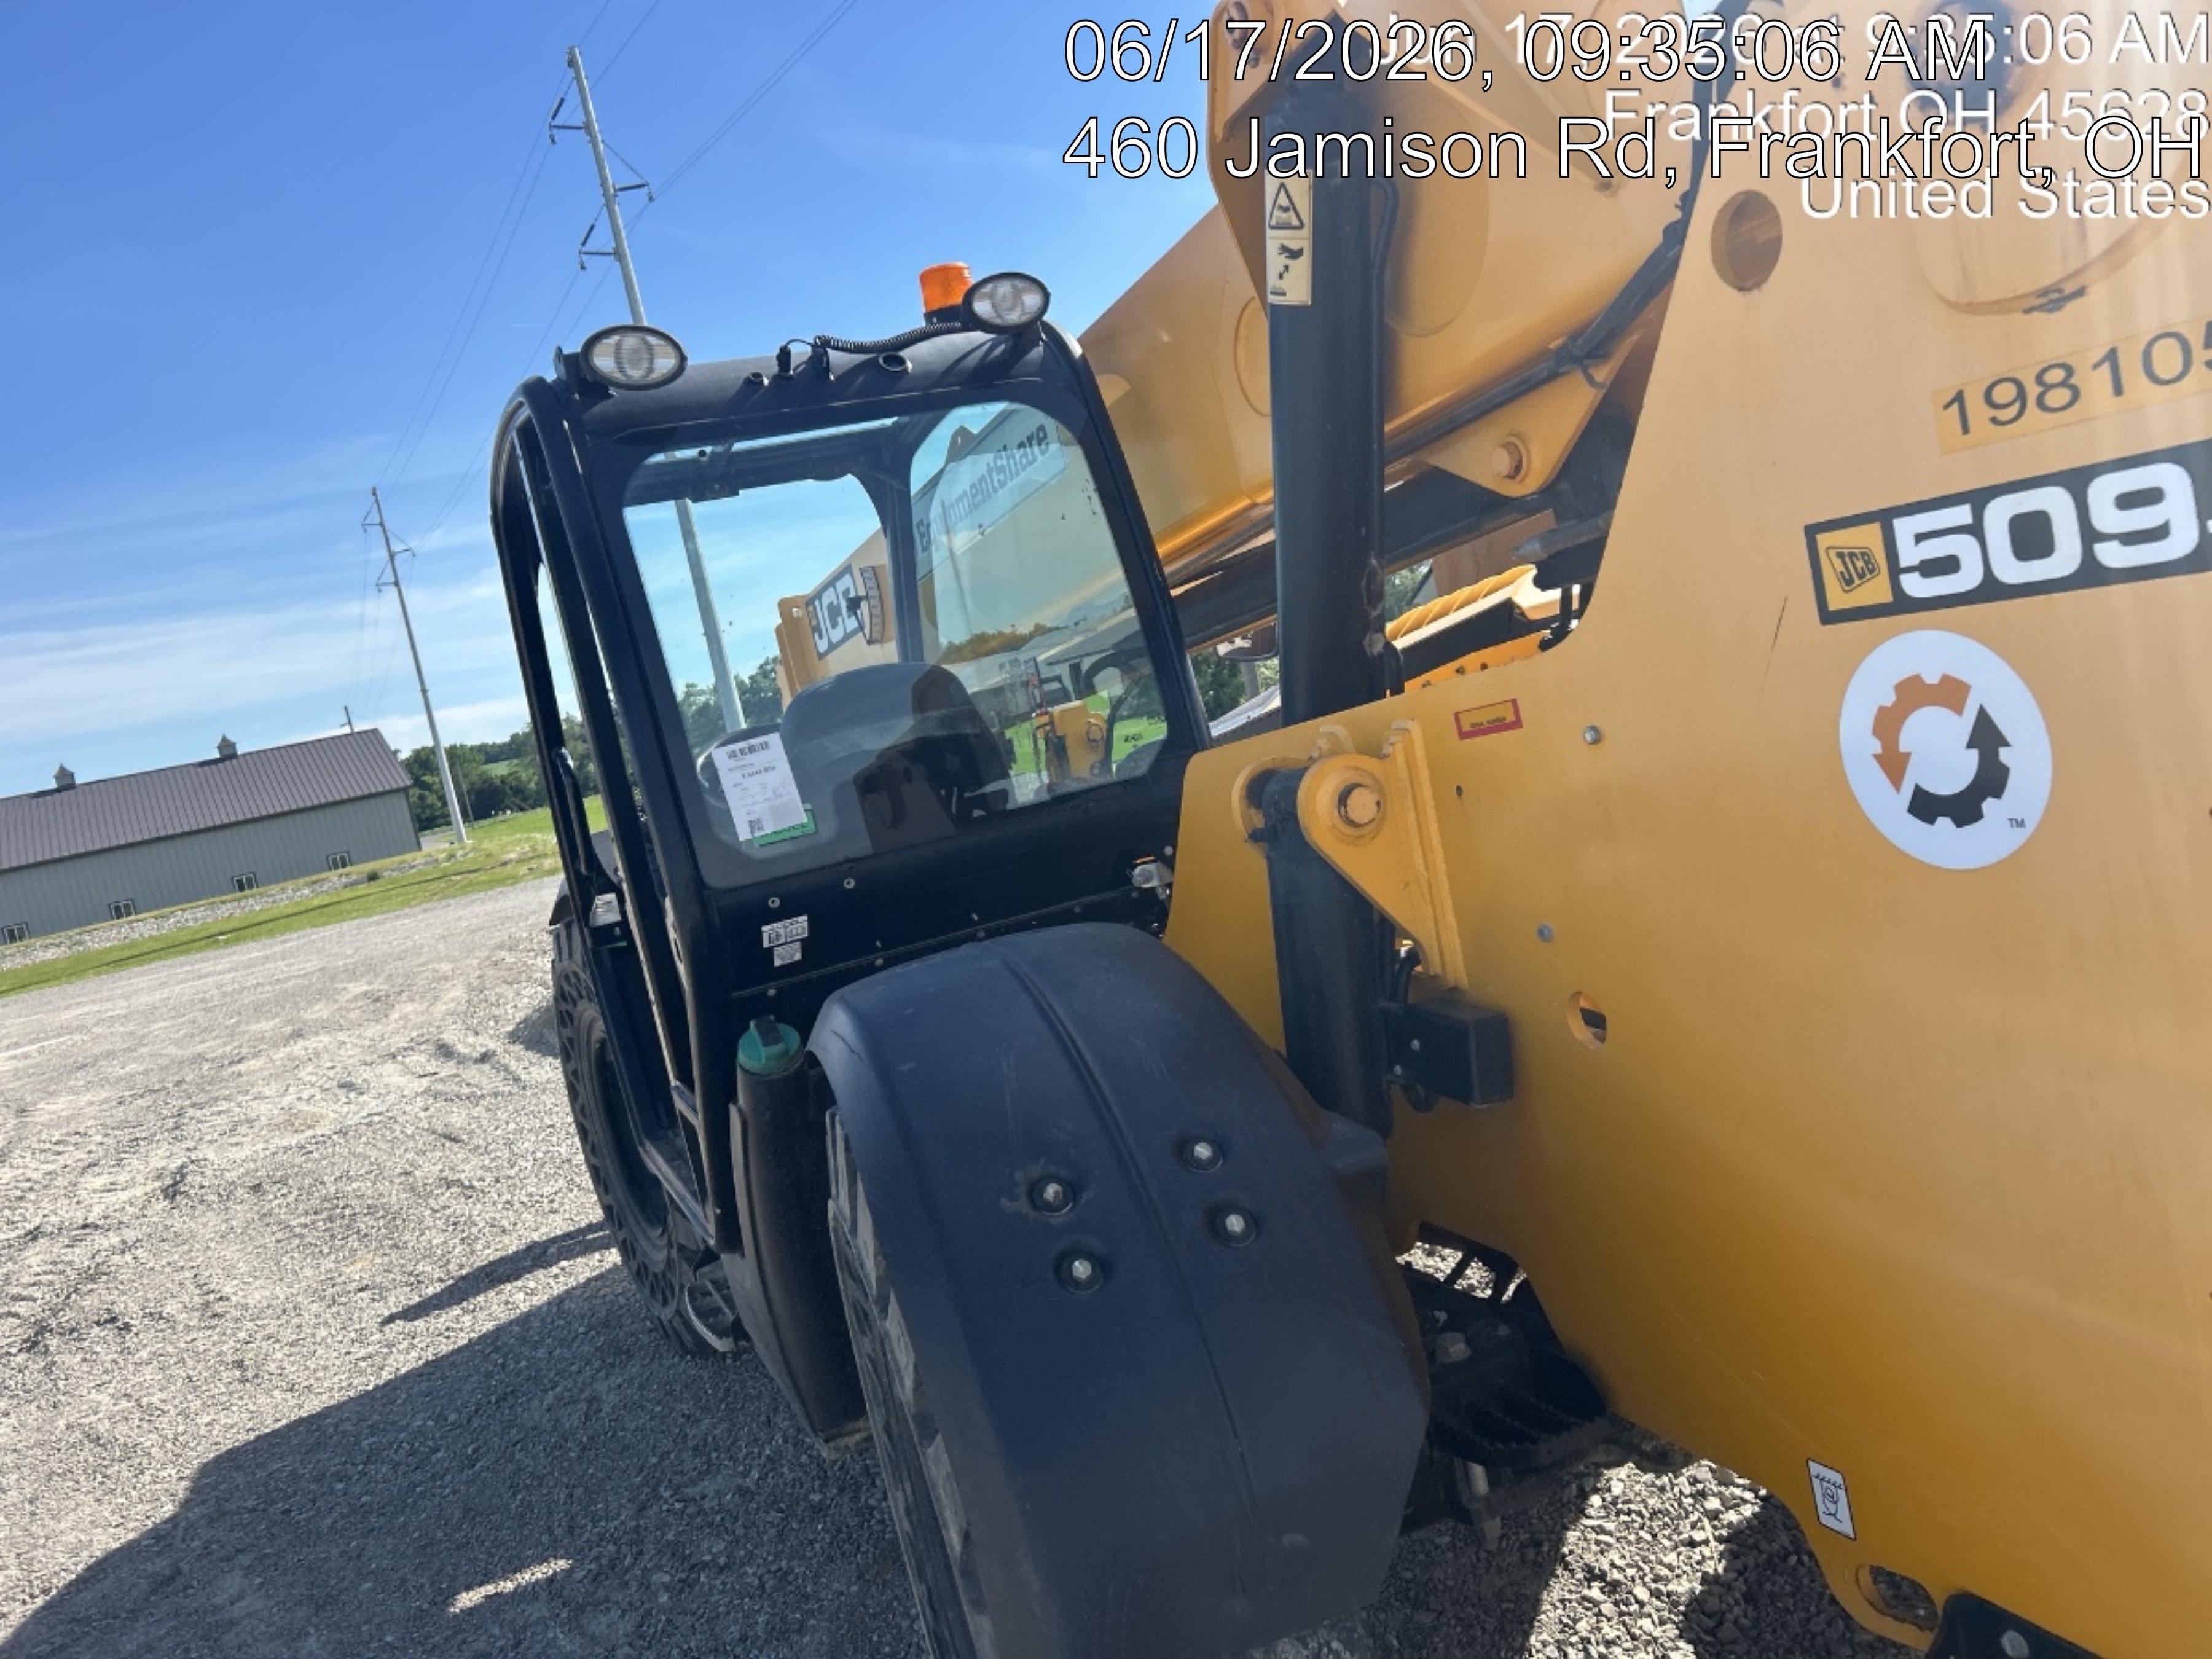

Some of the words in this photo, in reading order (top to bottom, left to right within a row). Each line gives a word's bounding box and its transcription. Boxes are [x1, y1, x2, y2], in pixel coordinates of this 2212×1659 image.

[1941, 319, 2212, 436] 19810
[1835, 551, 1878, 587] JCB
[1892, 461, 2212, 598] 509
